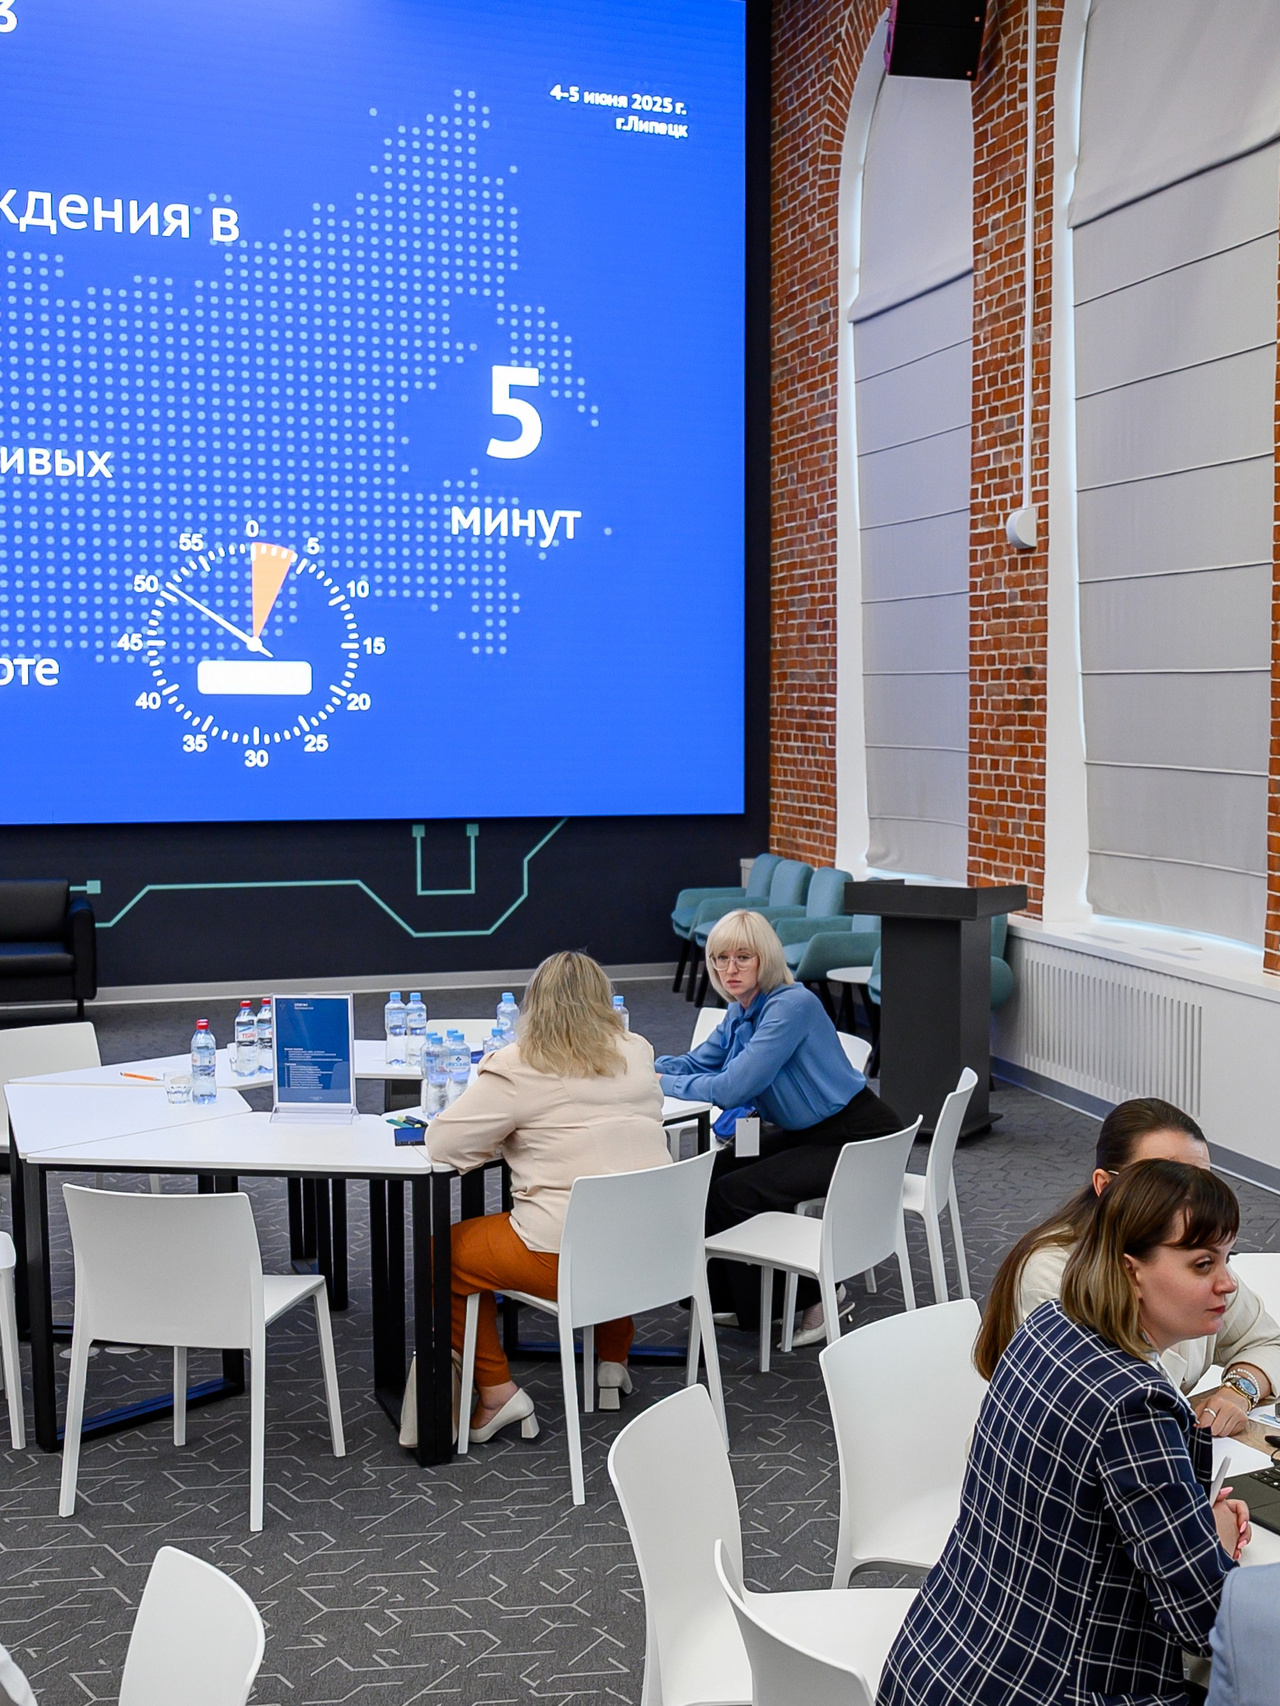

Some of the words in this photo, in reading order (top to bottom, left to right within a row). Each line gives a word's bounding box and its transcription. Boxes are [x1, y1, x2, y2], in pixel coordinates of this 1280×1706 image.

[550, 84, 579, 102] 4-5
[583, 91, 628, 108] июня
[631, 93, 673, 113] 2025
[675, 102, 687, 115] г.
[616, 115, 688, 139] г.Липецк
[212, 207, 240, 242] в
[486, 365, 542, 459] 5
[0, 446, 113, 478] ивых
[246, 520, 259, 537] 0
[451, 506, 582, 548] минут
[179, 533, 204, 552] 55
[307, 537, 320, 555] 5
[133, 574, 159, 593] 50
[346, 580, 369, 597] 10
[116, 633, 144, 651] 45
[363, 637, 386, 655] 15
[135, 692, 162, 710] 40
[346, 693, 371, 711] 20
[183, 734, 208, 753] 35
[303, 734, 329, 752] 25
[244, 749, 269, 768] 30
